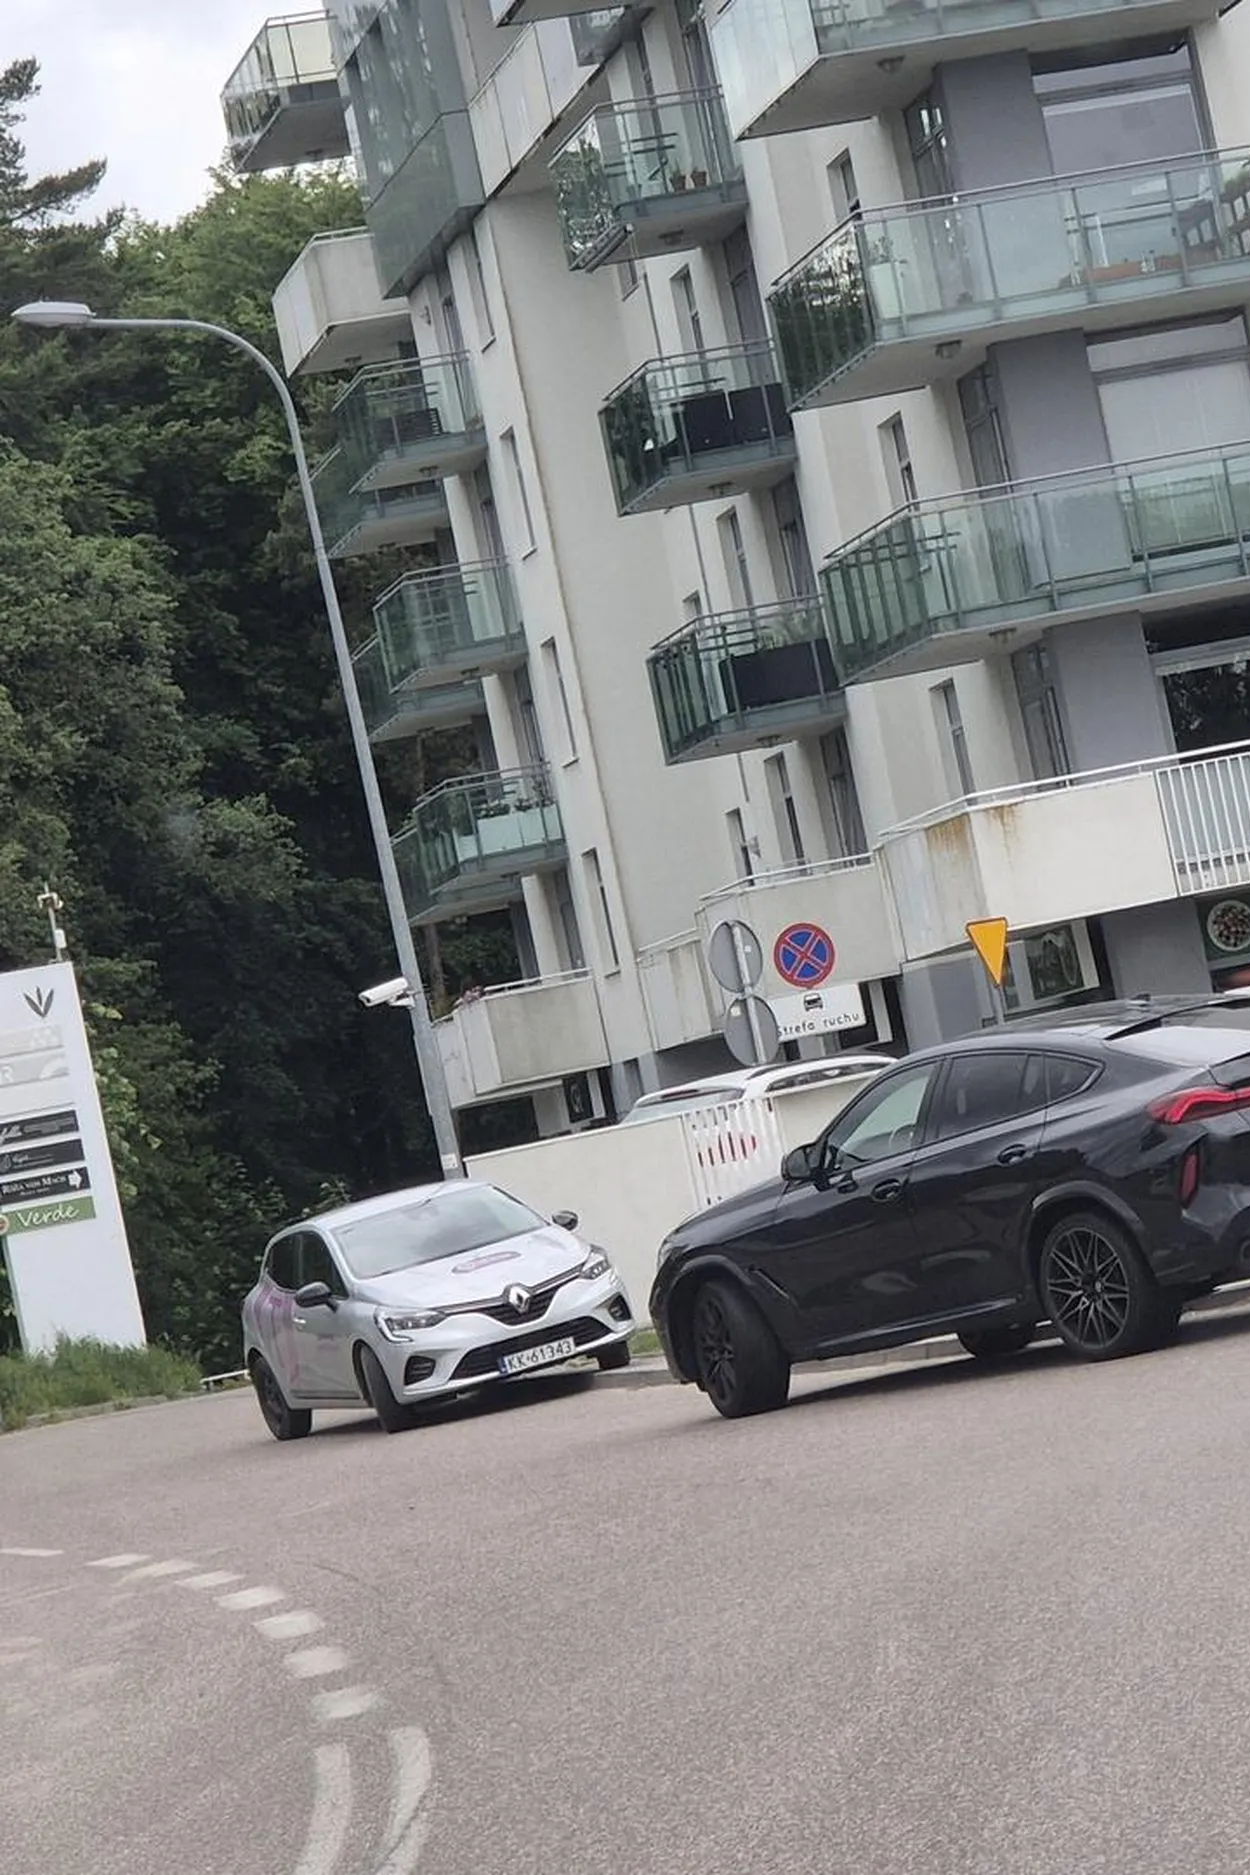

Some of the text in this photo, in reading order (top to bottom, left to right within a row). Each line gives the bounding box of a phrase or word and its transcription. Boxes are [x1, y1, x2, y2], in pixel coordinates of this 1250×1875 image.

[777, 1013, 860, 1037] Strefa ruchu
[17, 1203, 80, 1227] Verde
